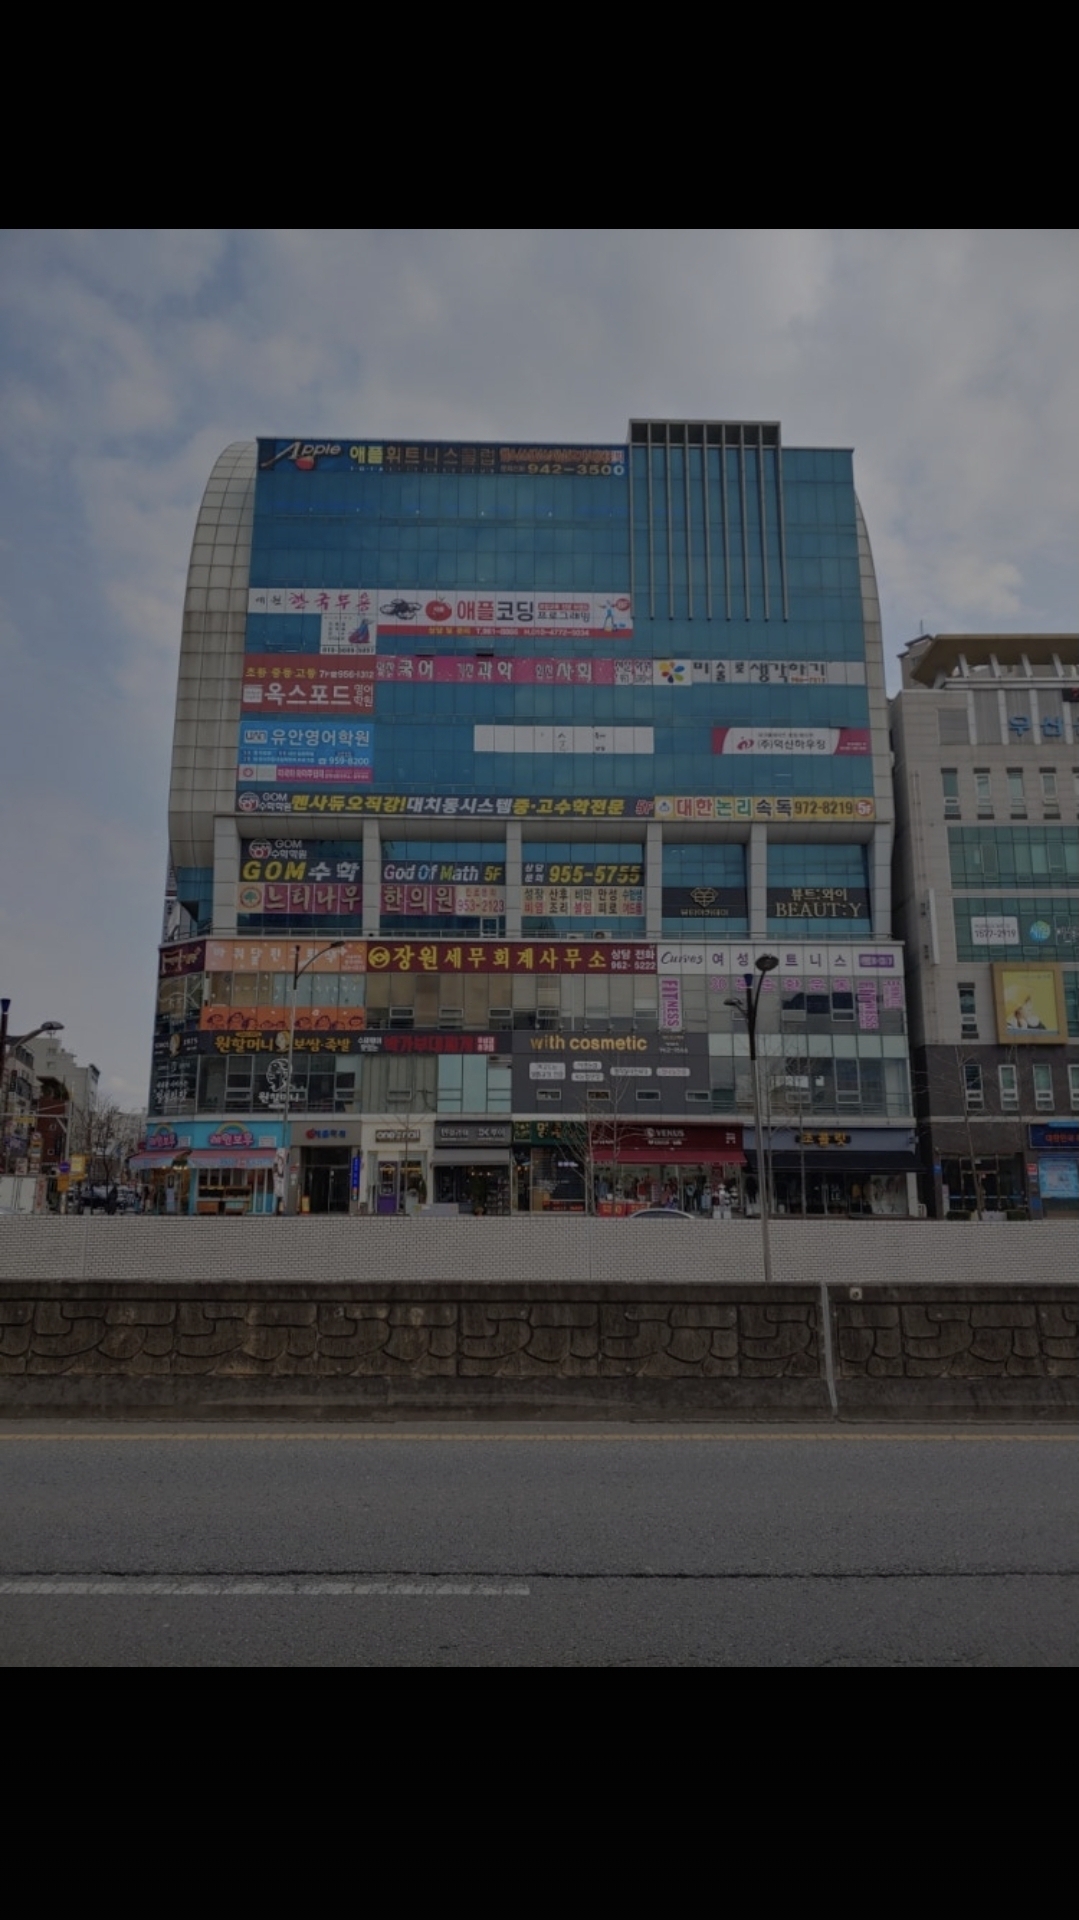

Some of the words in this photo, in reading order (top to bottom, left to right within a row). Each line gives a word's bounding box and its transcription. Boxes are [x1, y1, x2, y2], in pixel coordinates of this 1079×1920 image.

[261, 441, 341, 468] Apple
[527, 463, 625, 476] 942-3500
[457, 600, 533, 622] 애플코딩
[537, 611, 590, 623] 프로그래밍
[398, 658, 433, 679] 국어
[478, 660, 512, 679] 과학
[557, 661, 593, 681] 사회
[264, 683, 352, 706] 옥스포드
[270, 729, 370, 748] 유안영어학원
[262, 792, 288, 801] GOM
[259, 801, 292, 812] 수학학원
[795, 801, 854, 815] 972-8219
[275, 840, 302, 848] GOM
[271, 849, 308, 860] 수학학원
[242, 860, 307, 881] GOM
[308, 861, 361, 882] 수학
[384, 864, 416, 881] God
[417, 864, 438, 881] Of
[440, 865, 480, 882] Math
[484, 865, 503, 882] 5F
[524, 863, 544, 873] 상담
[549, 865, 641, 885] 955-5755
[524, 873, 544, 883] 문의
[384, 885, 453, 913] 한의원
[524, 888, 544, 901] 성장
[549, 888, 568, 901] 산후
[574, 889, 592, 901] 비만
[597, 889, 618, 901] 만성
[457, 899, 505, 913] 953-2123
[524, 902, 544, 915] 비염
[549, 902, 568, 915] 조리
[776, 901, 862, 918] BEAUT:Y
[974, 929, 1017, 939] 1577-2919
[392, 945, 607, 970] 장원세무회계사무소
[611, 950, 632, 960] 상담
[635, 950, 656, 960] 전화
[661, 979, 681, 1028] FITNESS
[215, 1035, 273, 1053] 원할머니
[530, 1035, 566, 1049] with
[569, 1036, 648, 1051] cosmetic
[655, 1129, 685, 1138] VENUS
